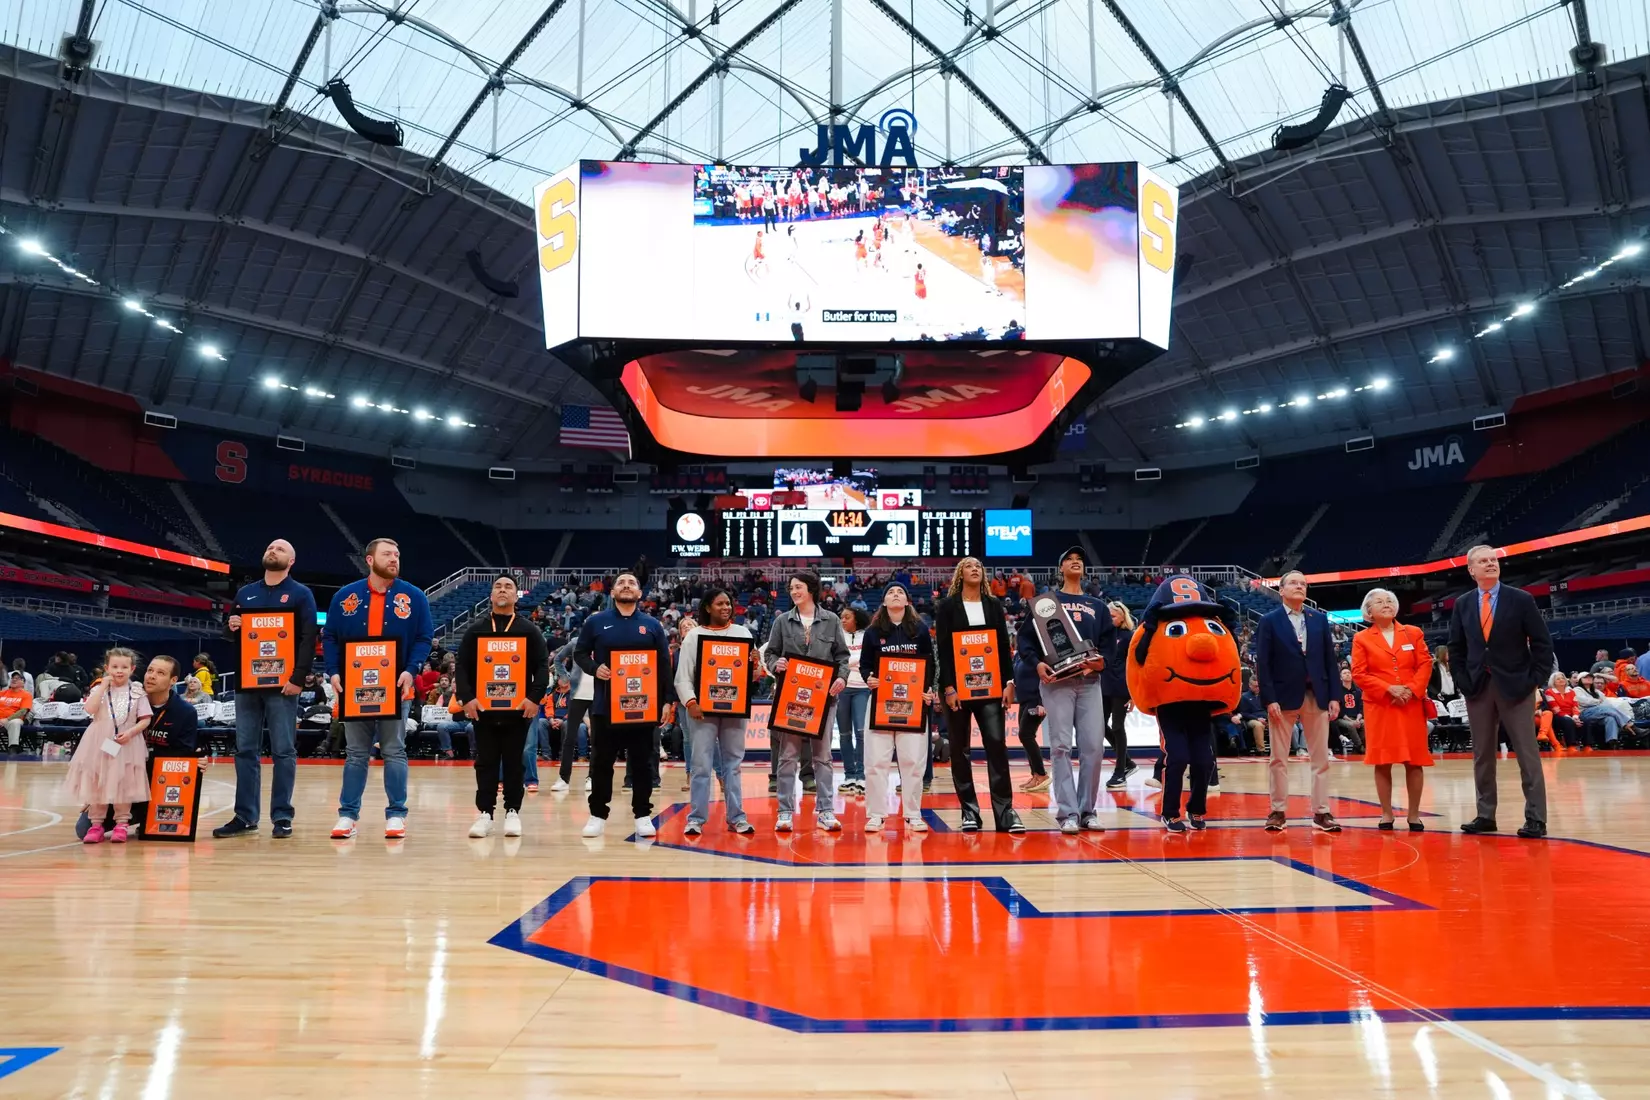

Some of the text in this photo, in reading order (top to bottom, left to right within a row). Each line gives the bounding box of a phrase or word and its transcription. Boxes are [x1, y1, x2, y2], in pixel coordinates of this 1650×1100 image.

[800, 122, 917, 166] JMA
[537, 177, 577, 273] S
[1140, 178, 1175, 273] S
[823, 311, 896, 322] Butler for three
[686, 384, 798, 412] JMA
[893, 383, 1000, 414] JMA
[215, 440, 248, 484] S
[1408, 441, 1466, 470] JMA
[288, 464, 375, 490] SYRACUSE
[833, 512, 863, 528] 14:34
[791, 522, 808, 545] 41
[887, 522, 908, 545] 30
[686, 544, 710, 553] WEBB
[1170, 578, 1201, 604] S
[393, 593, 412, 619] S
[252, 617, 282, 628] 'CUSE
[489, 641, 515, 651] 'CUSE
[962, 634, 987, 645] 'CUSE
[357, 645, 384, 656] 'CUSE
[713, 645, 738, 656] 'CUSE
[621, 654, 645, 665] 'CUSE
[890, 661, 915, 672] 'CUSE
[798, 664, 822, 678] 'CUSE
[1344, 693, 1356, 709] S
[164, 760, 188, 772] 'CUSE
